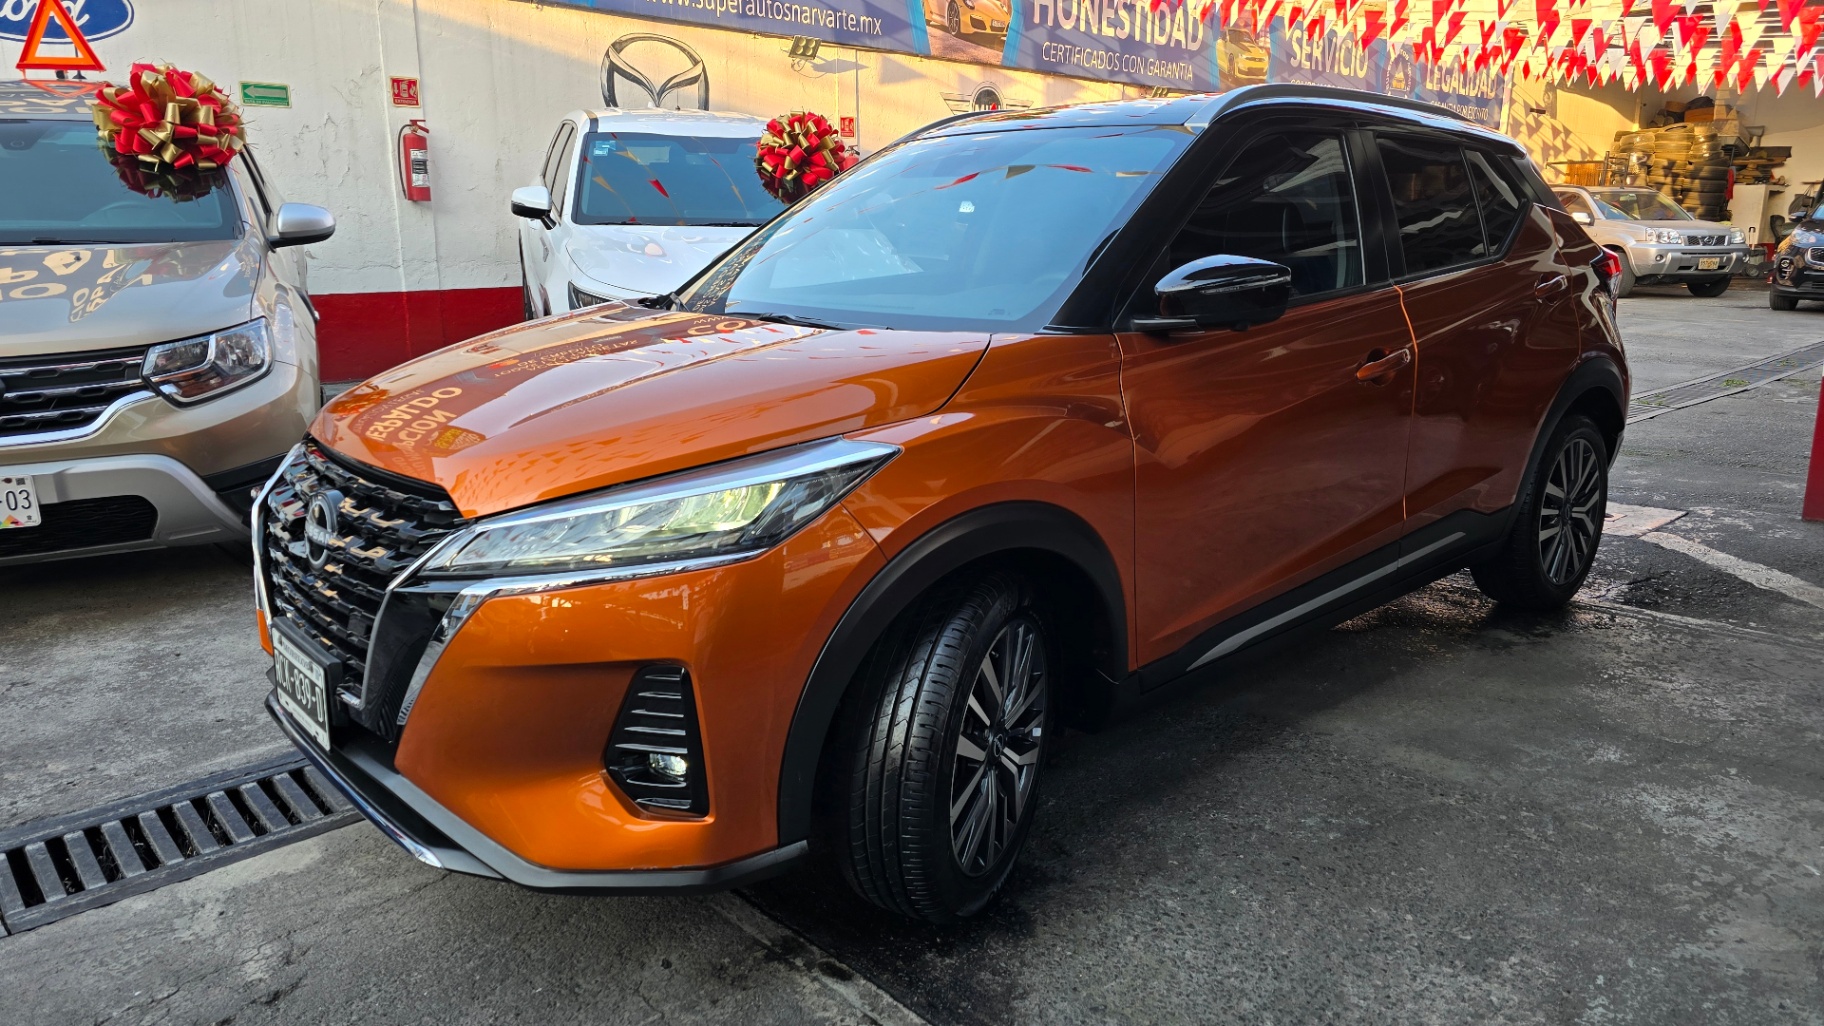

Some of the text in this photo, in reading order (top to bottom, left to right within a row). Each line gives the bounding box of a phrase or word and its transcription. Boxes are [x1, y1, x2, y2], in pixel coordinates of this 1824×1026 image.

[646, 0, 883, 36] .superautosnarvarte.mx
[1033, 0, 1204, 51] HONESTIDAD
[1042, 41, 1193, 82] CERTIFICADOS CON GARANTIA
[1290, 28, 1369, 78] SERVICIO
[1426, 57, 1497, 100] LEGALIDAD
